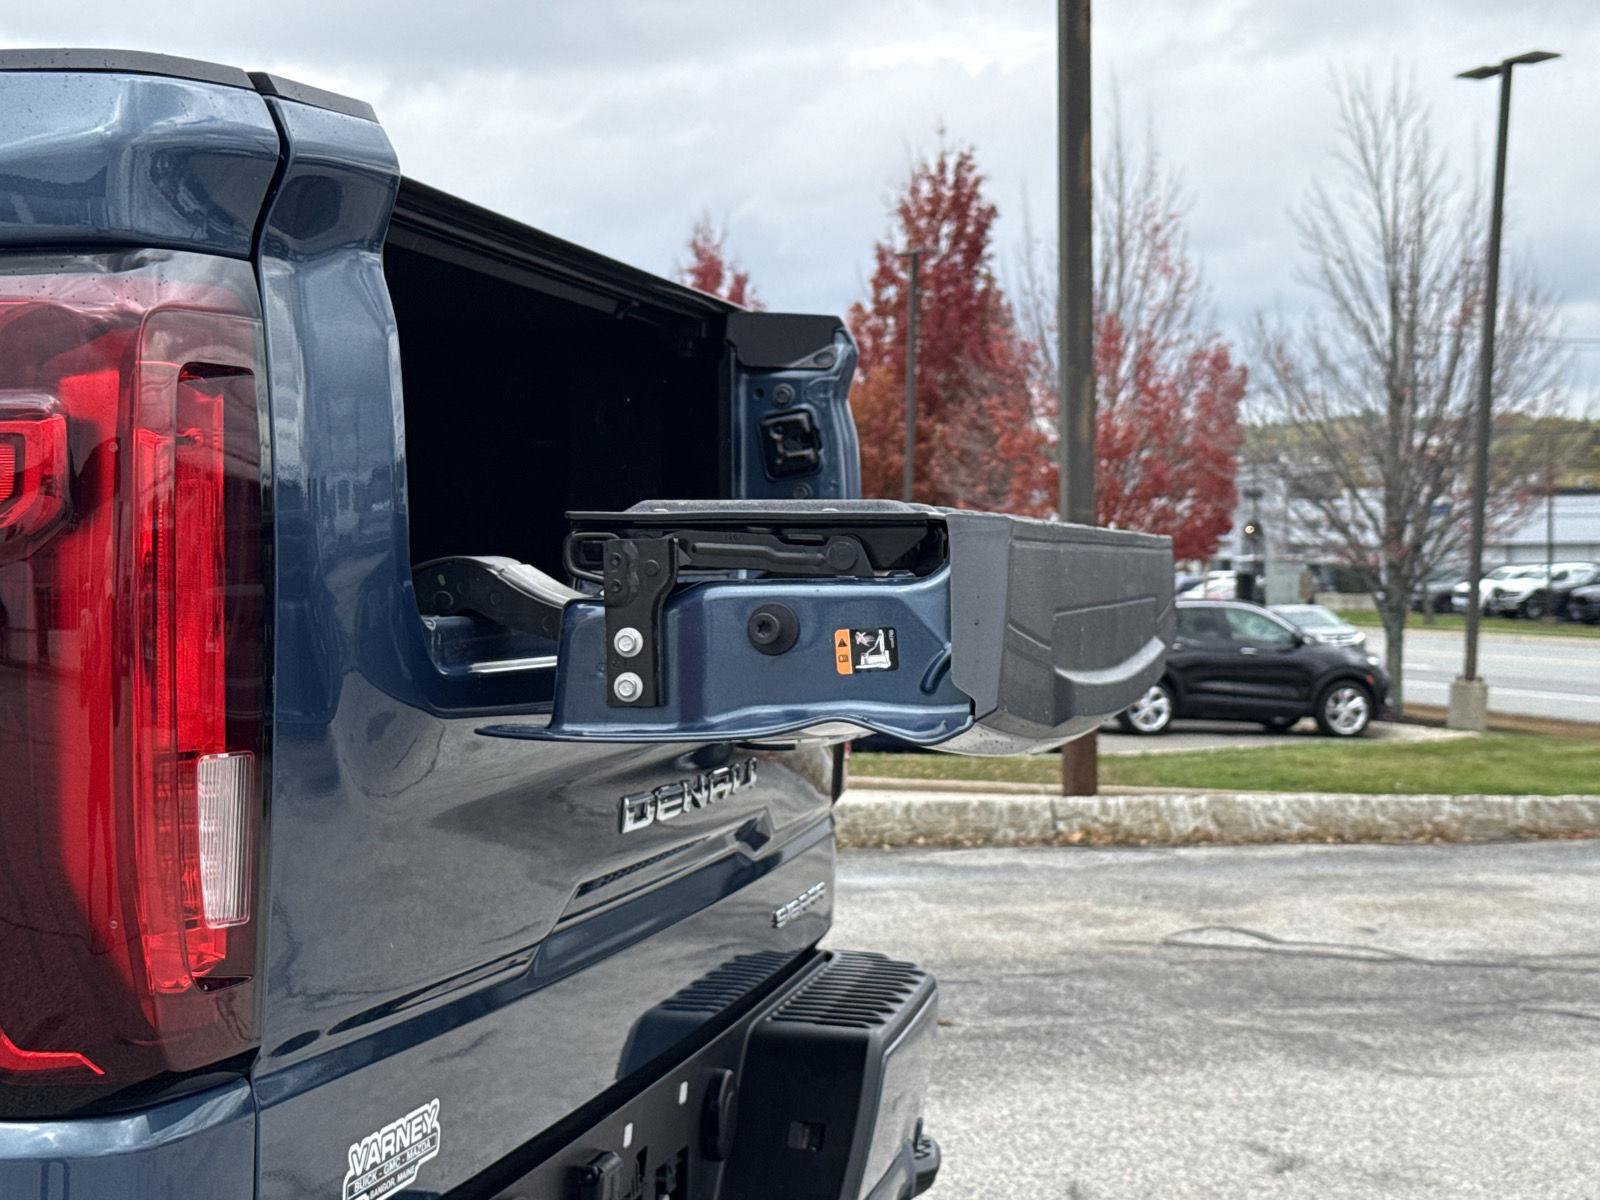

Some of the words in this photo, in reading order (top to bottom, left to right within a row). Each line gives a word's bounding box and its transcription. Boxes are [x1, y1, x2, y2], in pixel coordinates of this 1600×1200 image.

[620, 757, 757, 833] DENALI
[351, 1104, 437, 1176] VARNEY
[353, 1170, 378, 1193] BUICK
[383, 1157, 401, 1174] GMC
[406, 1139, 431, 1161] MAZDA
[396, 1164, 416, 1183] MAINE
